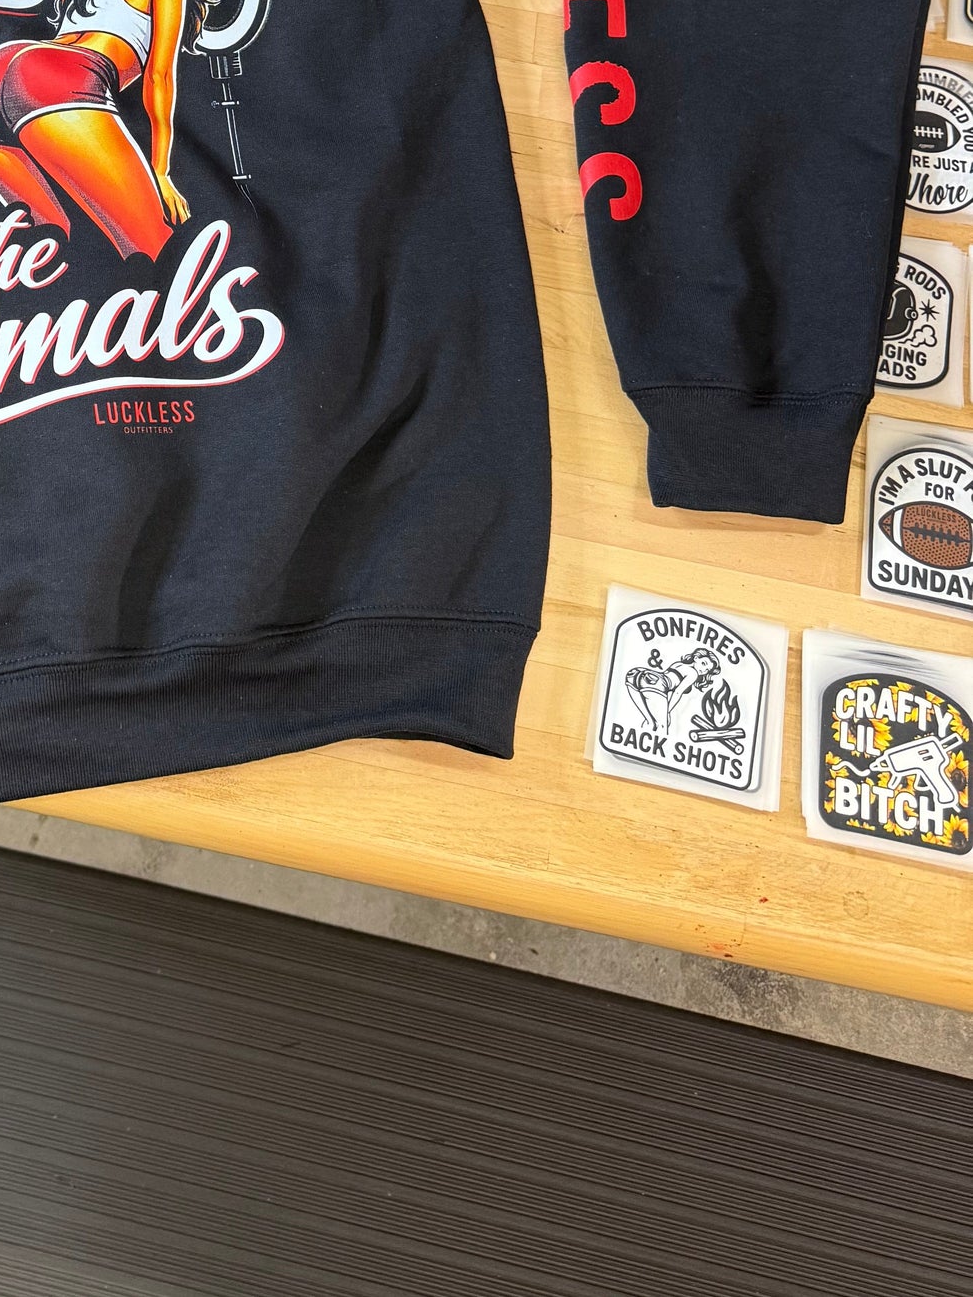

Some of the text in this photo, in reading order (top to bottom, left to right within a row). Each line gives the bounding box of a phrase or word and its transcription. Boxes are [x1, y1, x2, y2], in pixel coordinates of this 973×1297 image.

[933, 157, 967, 173] JUST
[904, 264, 946, 300] RODS
[885, 343, 927, 366] GING
[878, 358, 917, 381] ADS
[93, 400, 195, 426] LUCKLESS
[123, 426, 173, 434] OUTFITTERS
[878, 457, 967, 506] I'M A SLUT
[924, 481, 955, 501] FOR
[915, 506, 958, 523] LUCKLESS
[637, 616, 745, 666] BONFIRES
[647, 648, 665, 670] &
[834, 687, 953, 738] CRAFTY
[839, 720, 882, 756] LIL
[610, 722, 744, 781] BACK SHOTS
[834, 778, 944, 837] BITCH
